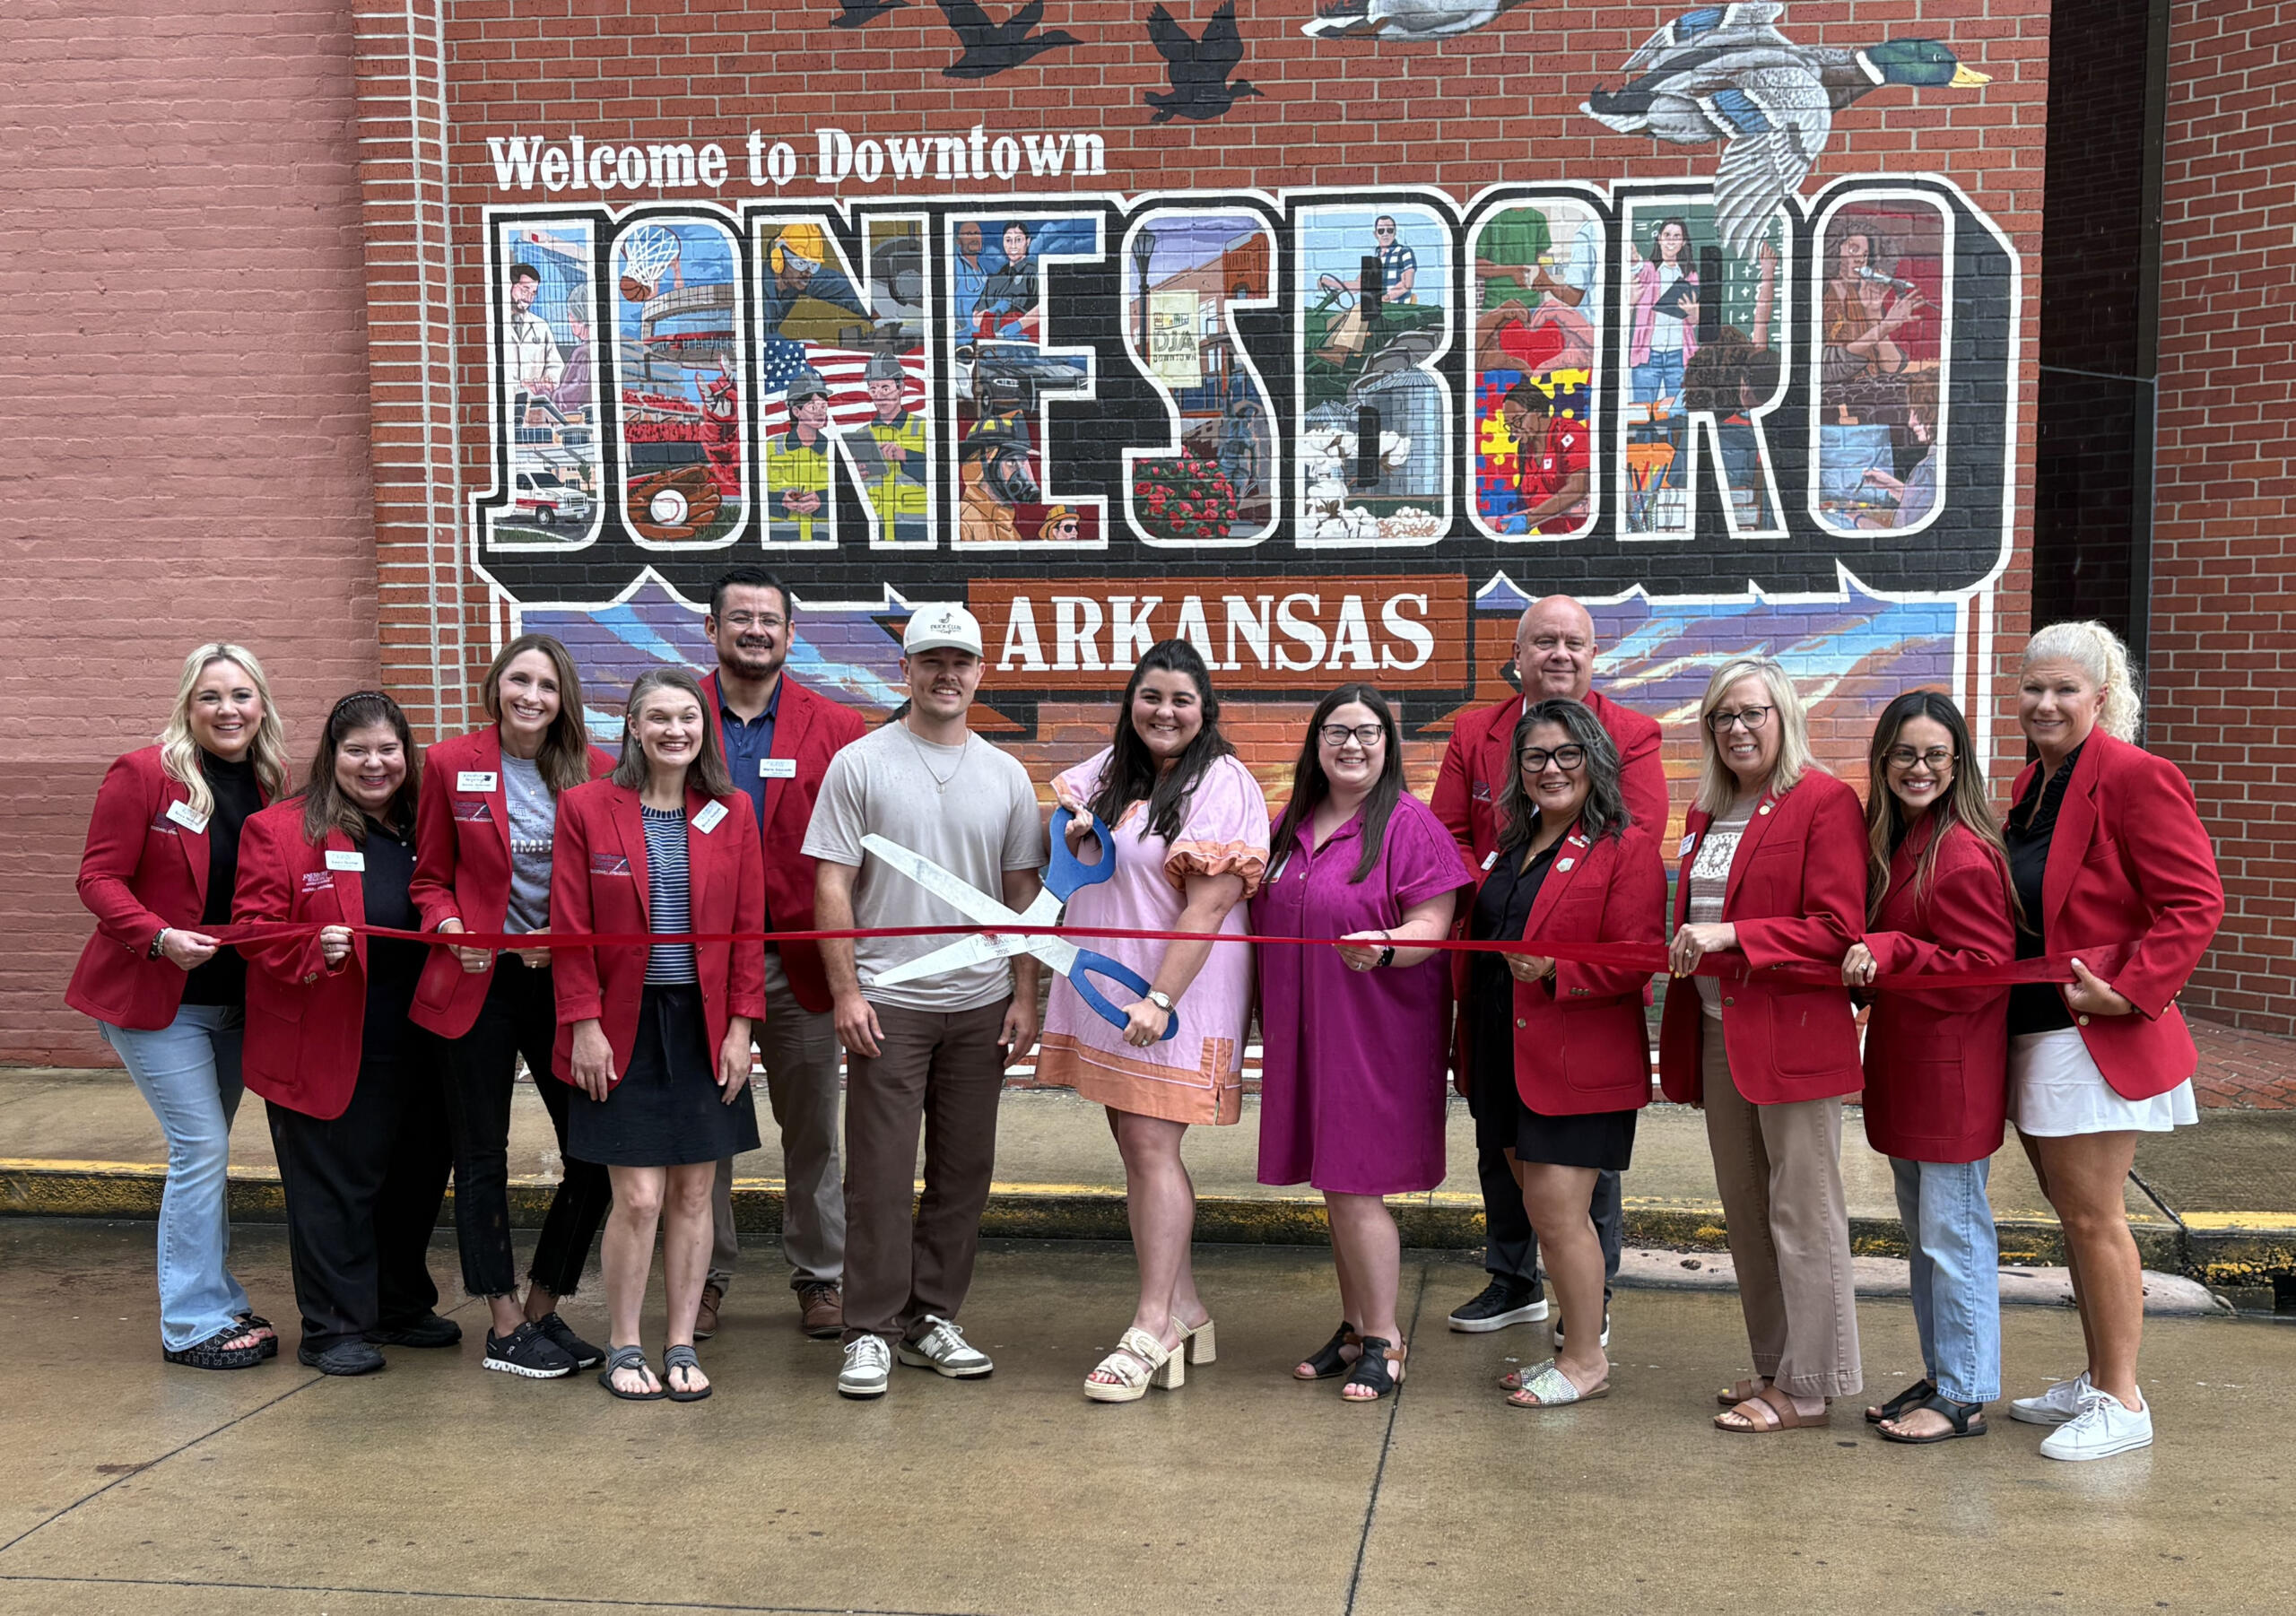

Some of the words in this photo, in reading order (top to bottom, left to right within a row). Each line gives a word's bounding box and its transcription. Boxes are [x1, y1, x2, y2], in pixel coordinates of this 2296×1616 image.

[486, 135, 728, 192] Welcome
[746, 128, 797, 187] to
[814, 124, 1107, 184] Downtown
[483, 188, 1957, 553] JONESBORO
[1153, 329, 1196, 352] DJA
[1153, 353, 1196, 362] DOWNTOWN
[996, 593, 1434, 671] ARKANSAS
